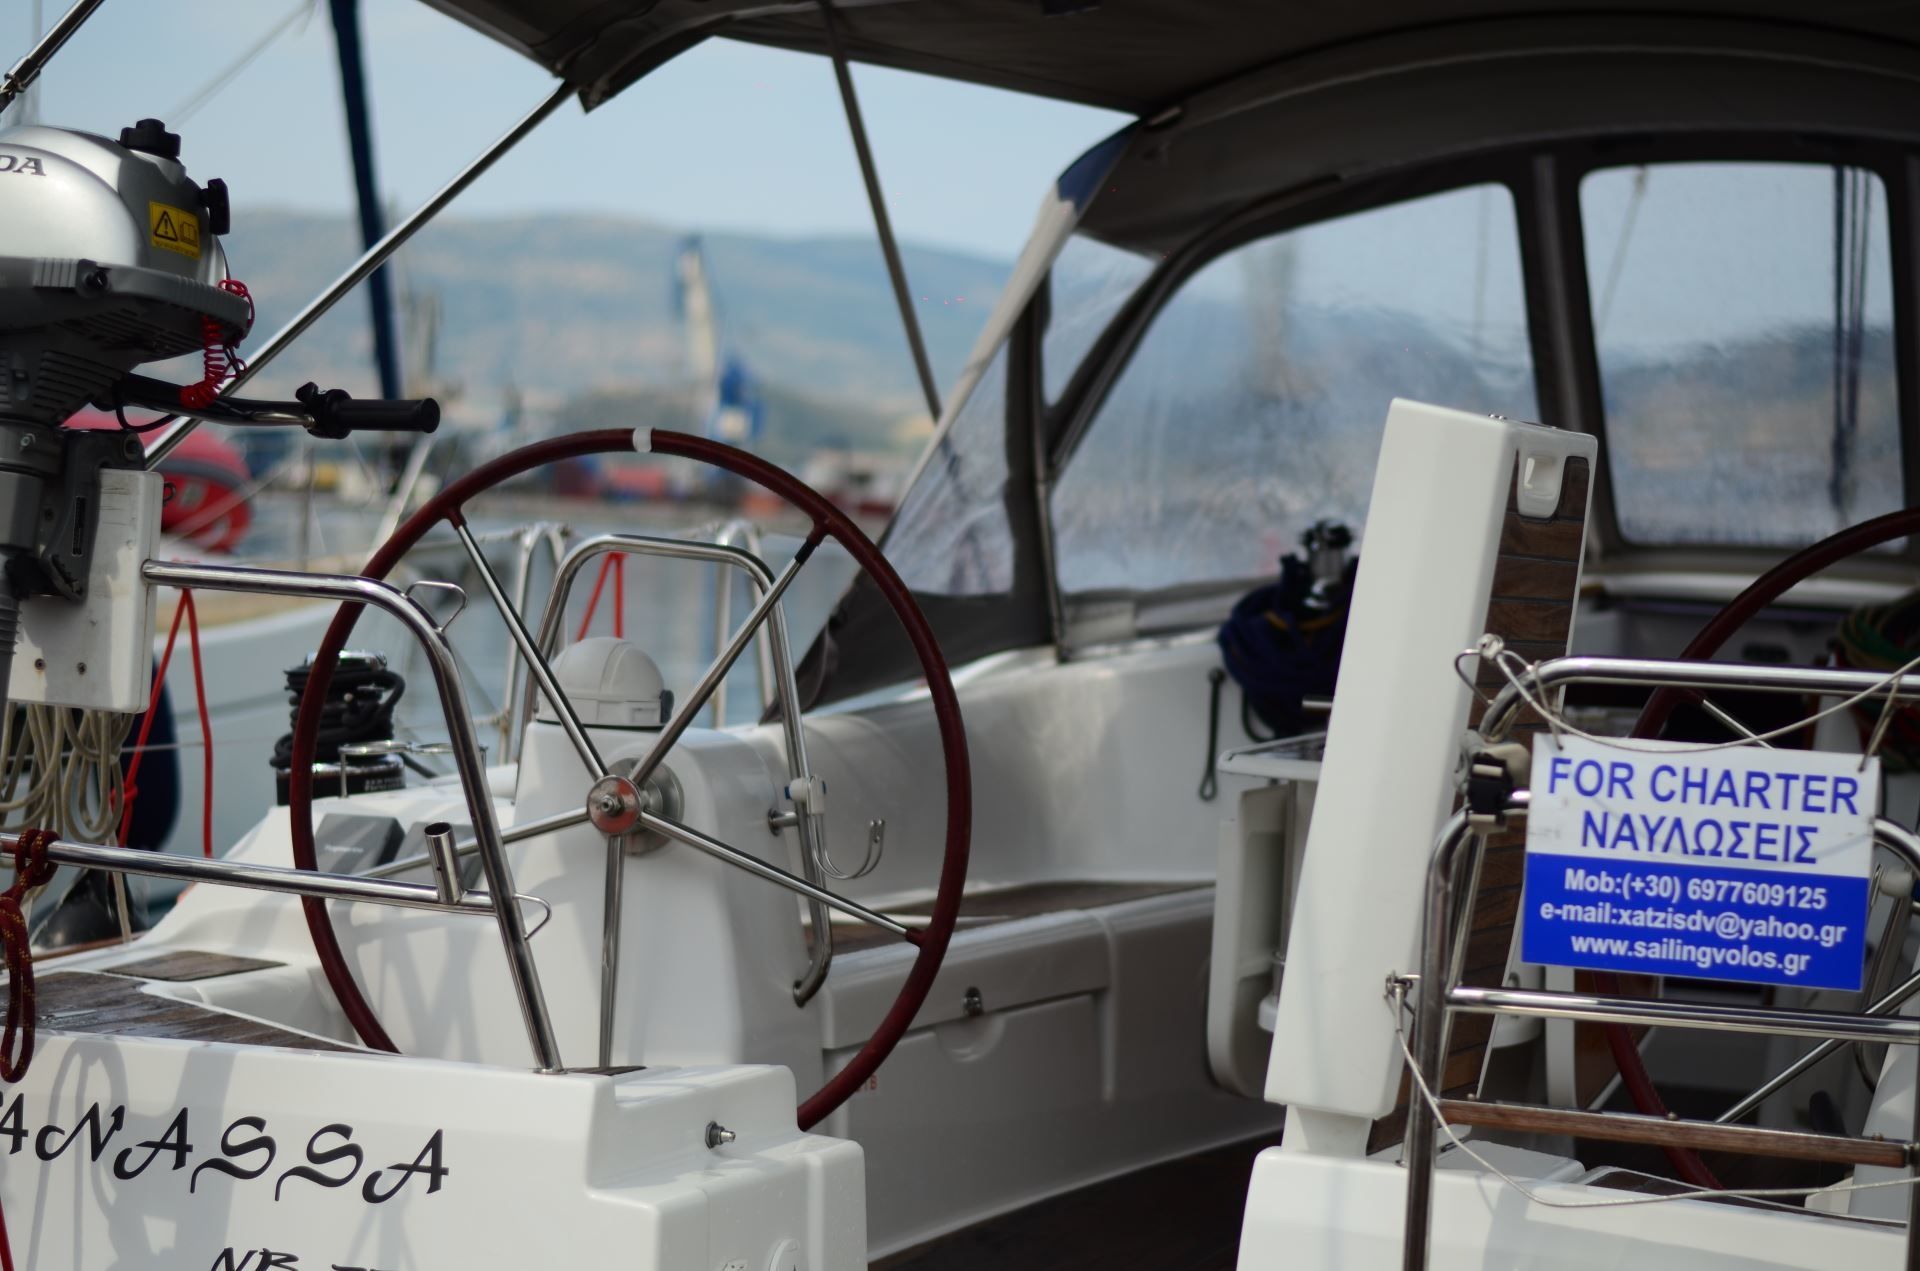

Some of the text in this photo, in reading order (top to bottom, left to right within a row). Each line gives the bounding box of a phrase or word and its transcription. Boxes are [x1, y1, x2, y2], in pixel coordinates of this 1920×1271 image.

[1548, 757, 1858, 815] FOR CHARTER
[1581, 810, 1819, 864] ΝΑΥΛΩΣΕΙΣ
[1564, 868, 1827, 910] Mob:(+30) 6977609125
[1540, 902, 1848, 947] e-mail:xatzisdv@yahoo.gr
[1571, 936, 1811, 975] www.sailingvolos.gr
[0, 1091, 449, 1203] ANASSA
